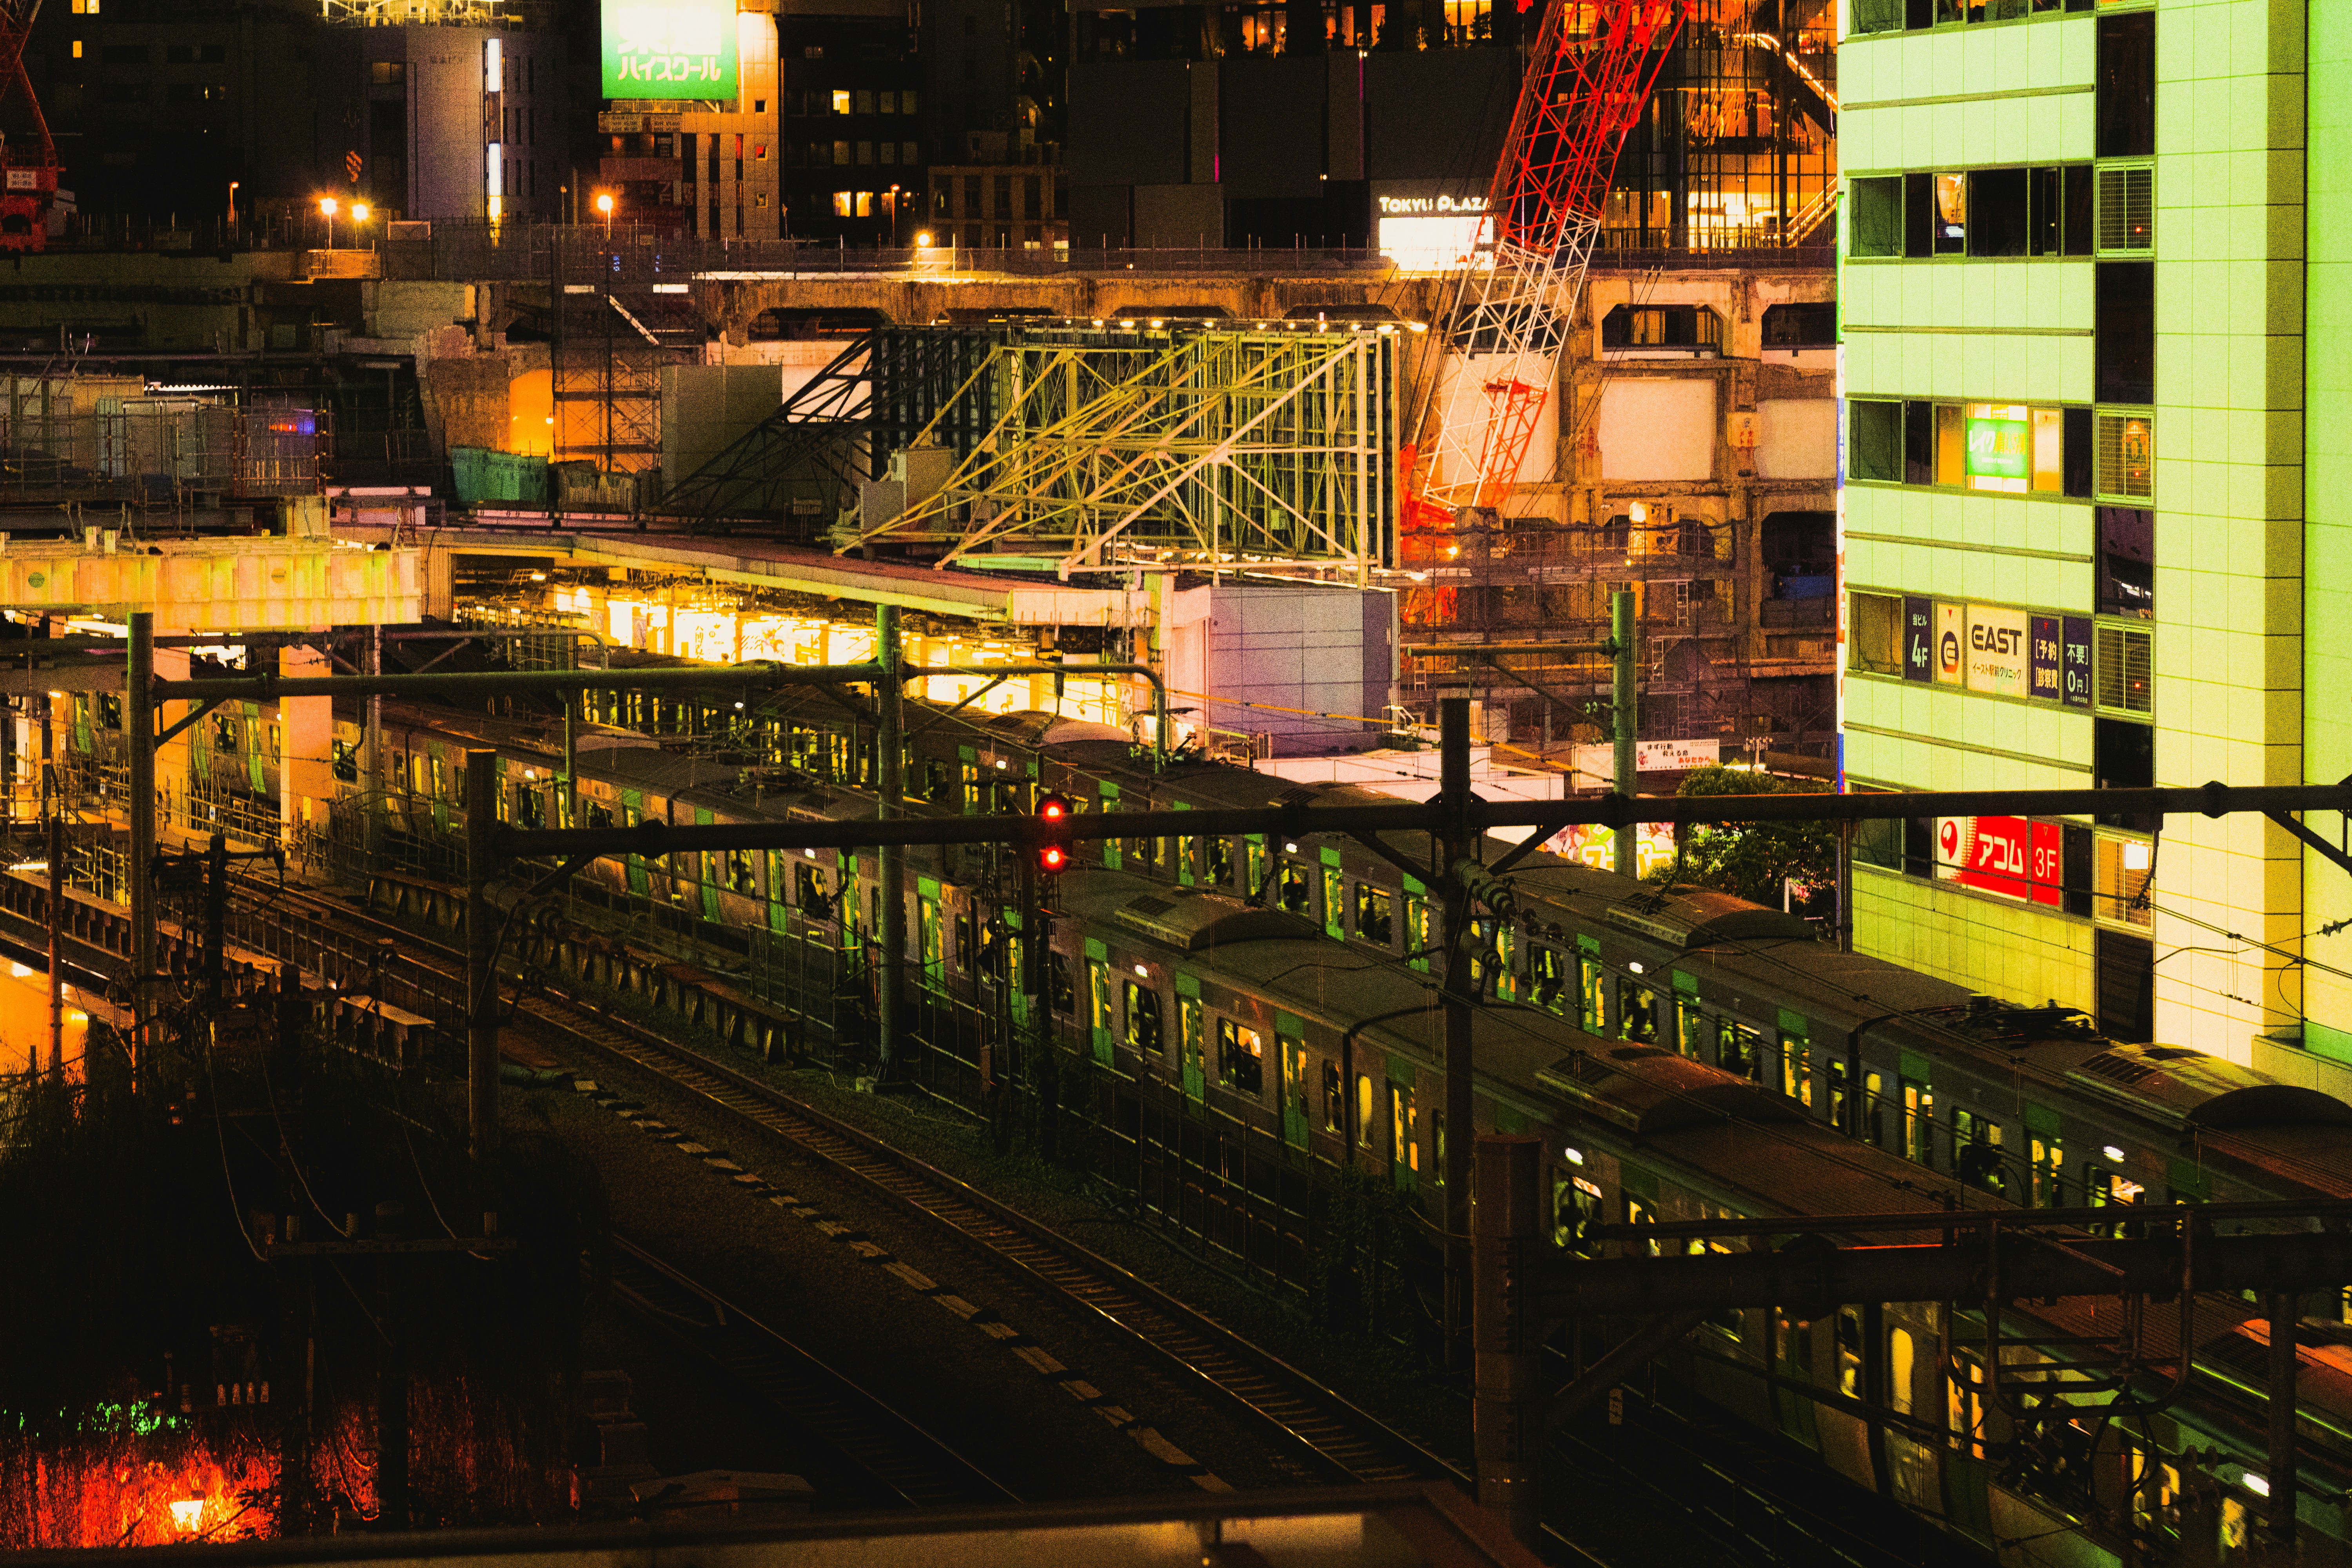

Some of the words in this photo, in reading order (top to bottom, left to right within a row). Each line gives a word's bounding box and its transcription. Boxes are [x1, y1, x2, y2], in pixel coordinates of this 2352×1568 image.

[618, 56, 721, 81] ハイスクール
[1379, 197, 1433, 212] TOKYU
[1913, 613, 1927, 626] 当ビル
[1912, 634, 1928, 668] 4F
[1972, 624, 2022, 655] EAST
[1973, 662, 2022, 680] イースト駅前クリニック
[1978, 833, 2024, 875] アコム
[2035, 847, 2056, 878] 3F
